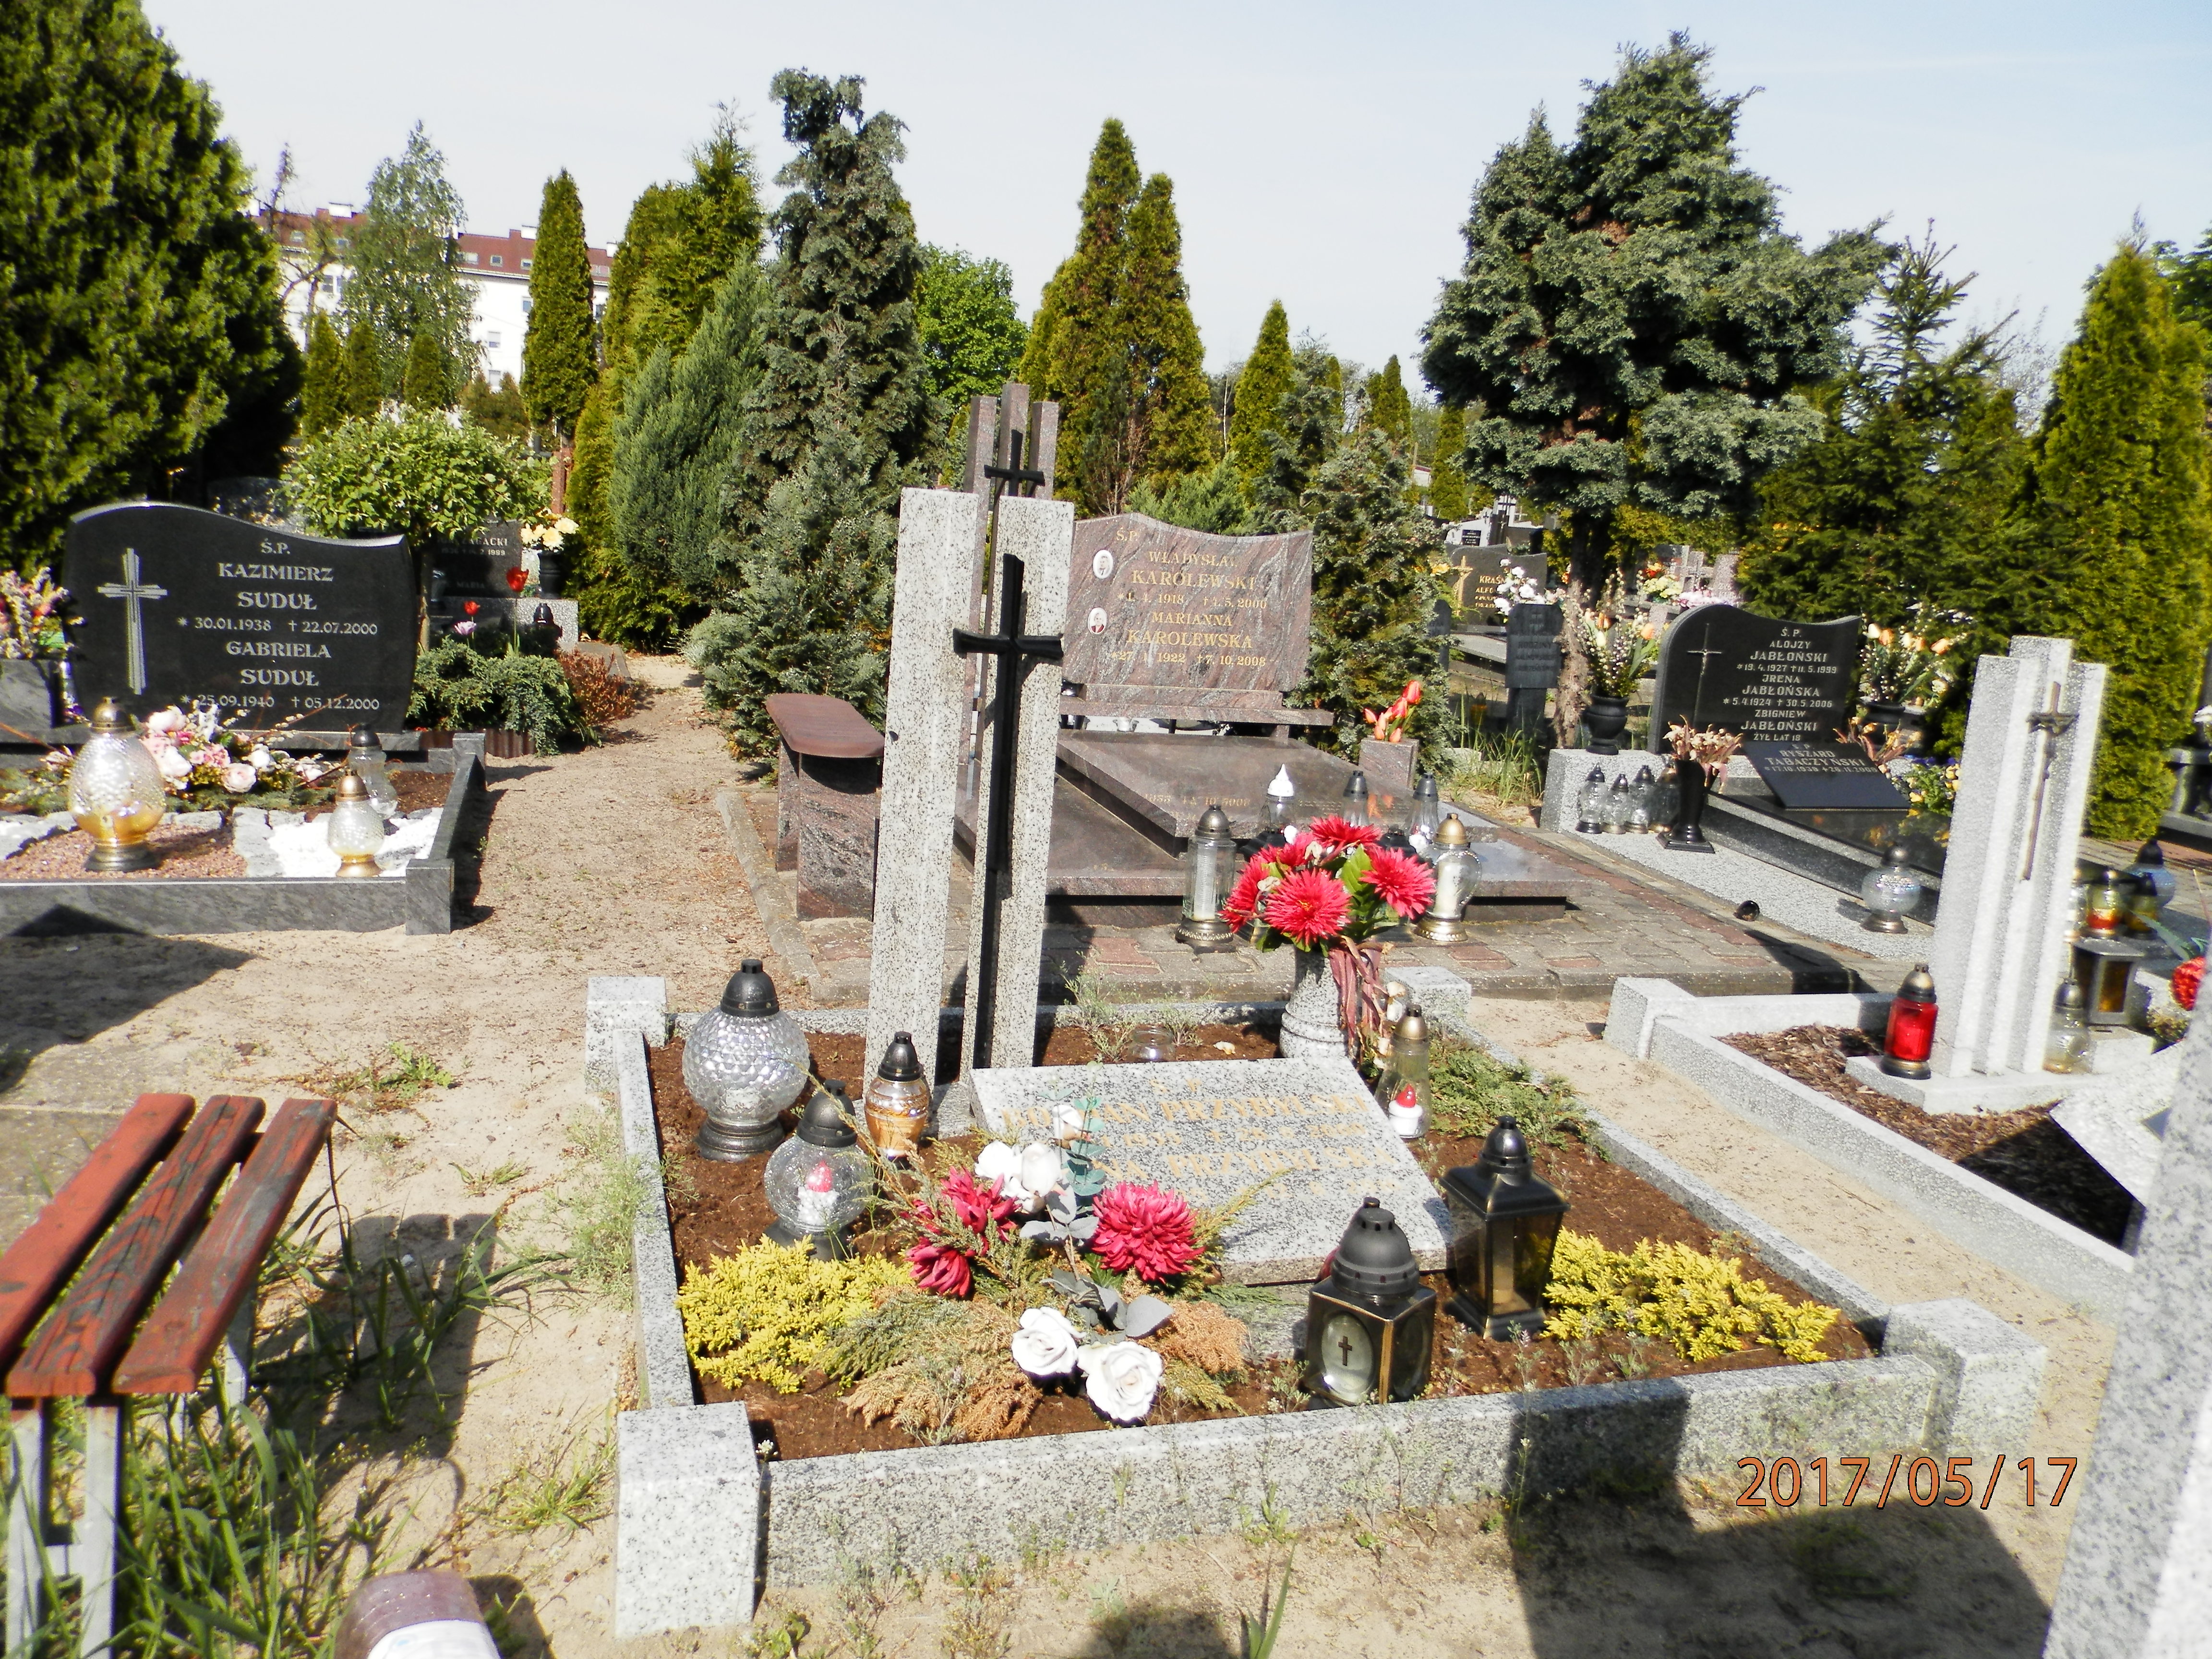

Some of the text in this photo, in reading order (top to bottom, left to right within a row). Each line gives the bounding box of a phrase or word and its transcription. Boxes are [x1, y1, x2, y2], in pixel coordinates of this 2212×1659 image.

[218, 563, 333, 582] KAZIMIERZ
[1132, 570, 1255, 590] KAROLEWSKI
[238, 592, 317, 610] SUDUŁ
[195, 617, 272, 631] 30.01.1938
[1152, 611, 1232, 626] MARIANNA
[303, 622, 378, 635] 22.07.2000
[1128, 629, 1253, 649] KAROLEWSKA
[1769, 640, 1811, 649] ALOJZY
[226, 641, 332, 658] GABRIELA
[1750, 650, 1828, 662] JABŁOŃSKI
[1157, 652, 1186, 663] 1922
[1237, 656, 1266, 666] 2008
[240, 669, 319, 686] SUDUŁ
[1742, 685, 1820, 697] JABŁOŃSKA
[1755, 709, 1806, 718] ZBIGNIEW
[1741, 720, 1818, 731] JABŁOŃSKI
[1764, 757, 1865, 766] TABACZYŃSKI
[1160, 1094, 1368, 1121] PRZYBYLSKI
